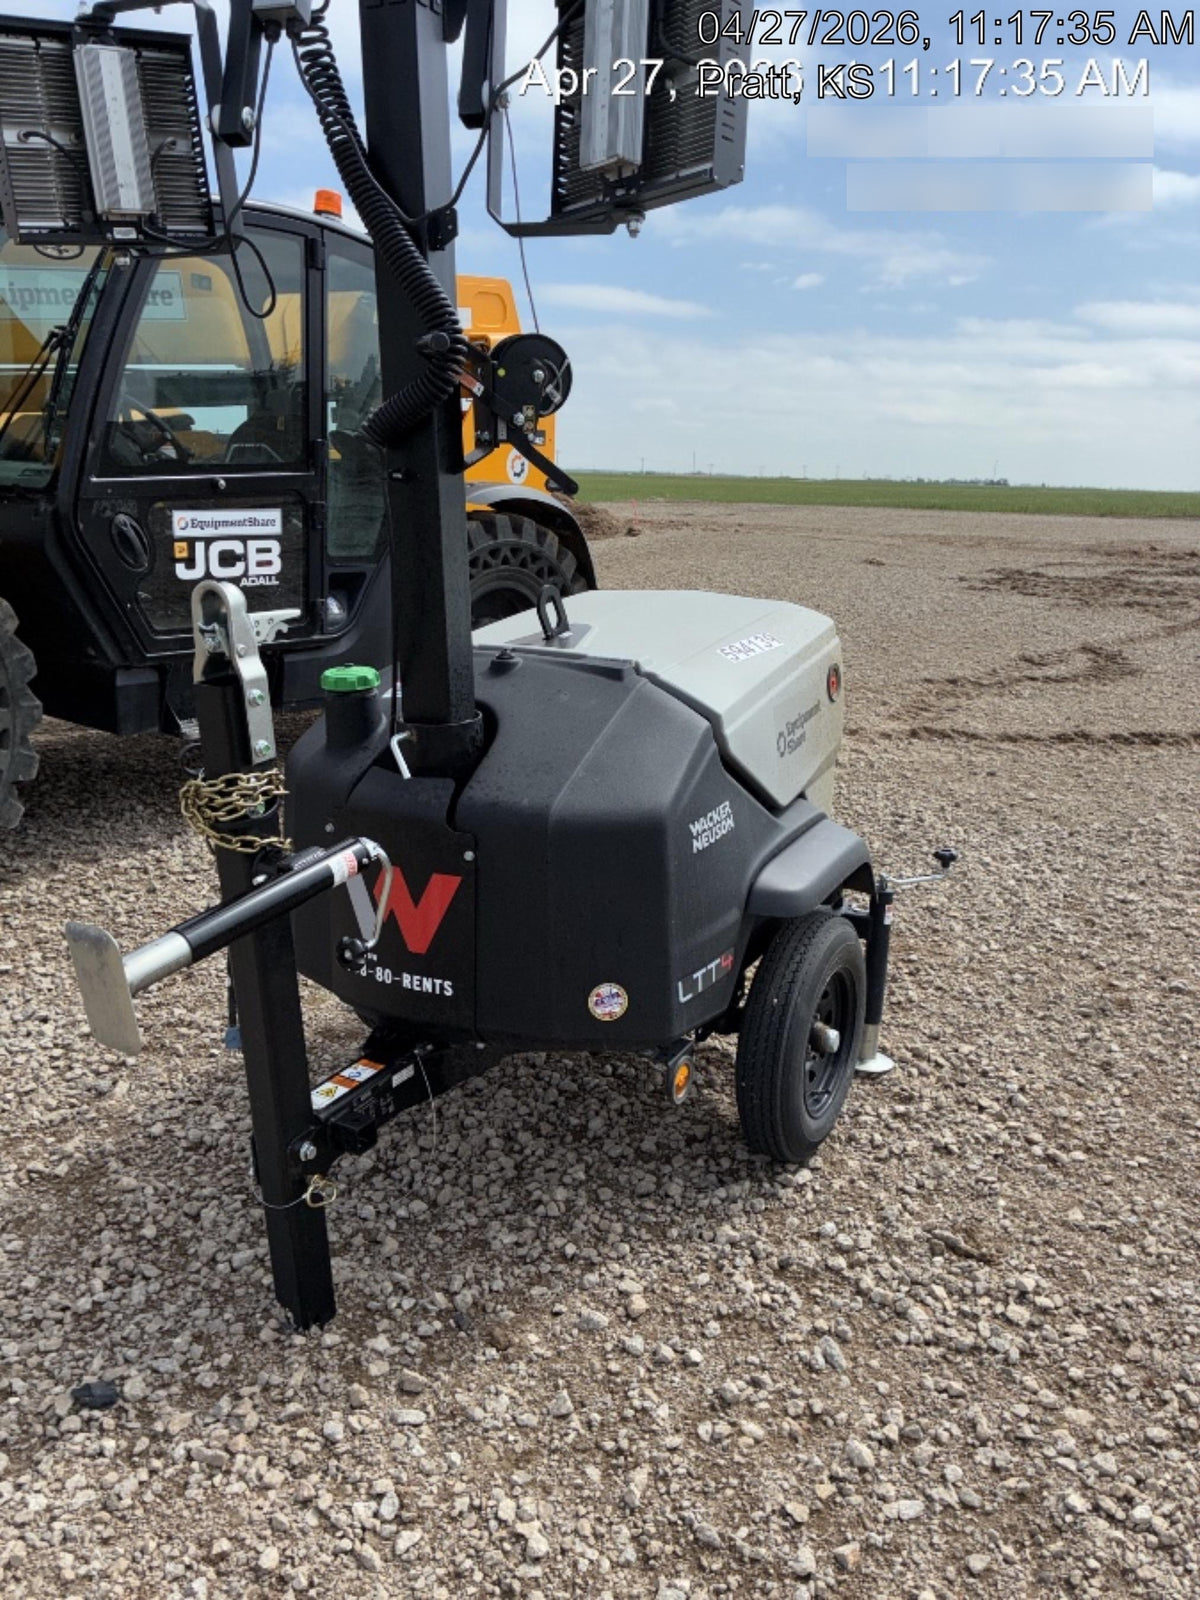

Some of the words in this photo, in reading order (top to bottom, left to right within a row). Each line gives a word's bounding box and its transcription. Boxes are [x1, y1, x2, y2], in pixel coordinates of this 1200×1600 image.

[190, 517, 276, 530] EquipmentShare
[174, 540, 282, 580] JCB
[240, 576, 279, 588] ADALL
[689, 800, 732, 837] WACKER
[692, 813, 735, 854] NEUSON
[677, 954, 734, 1003] LTT4
